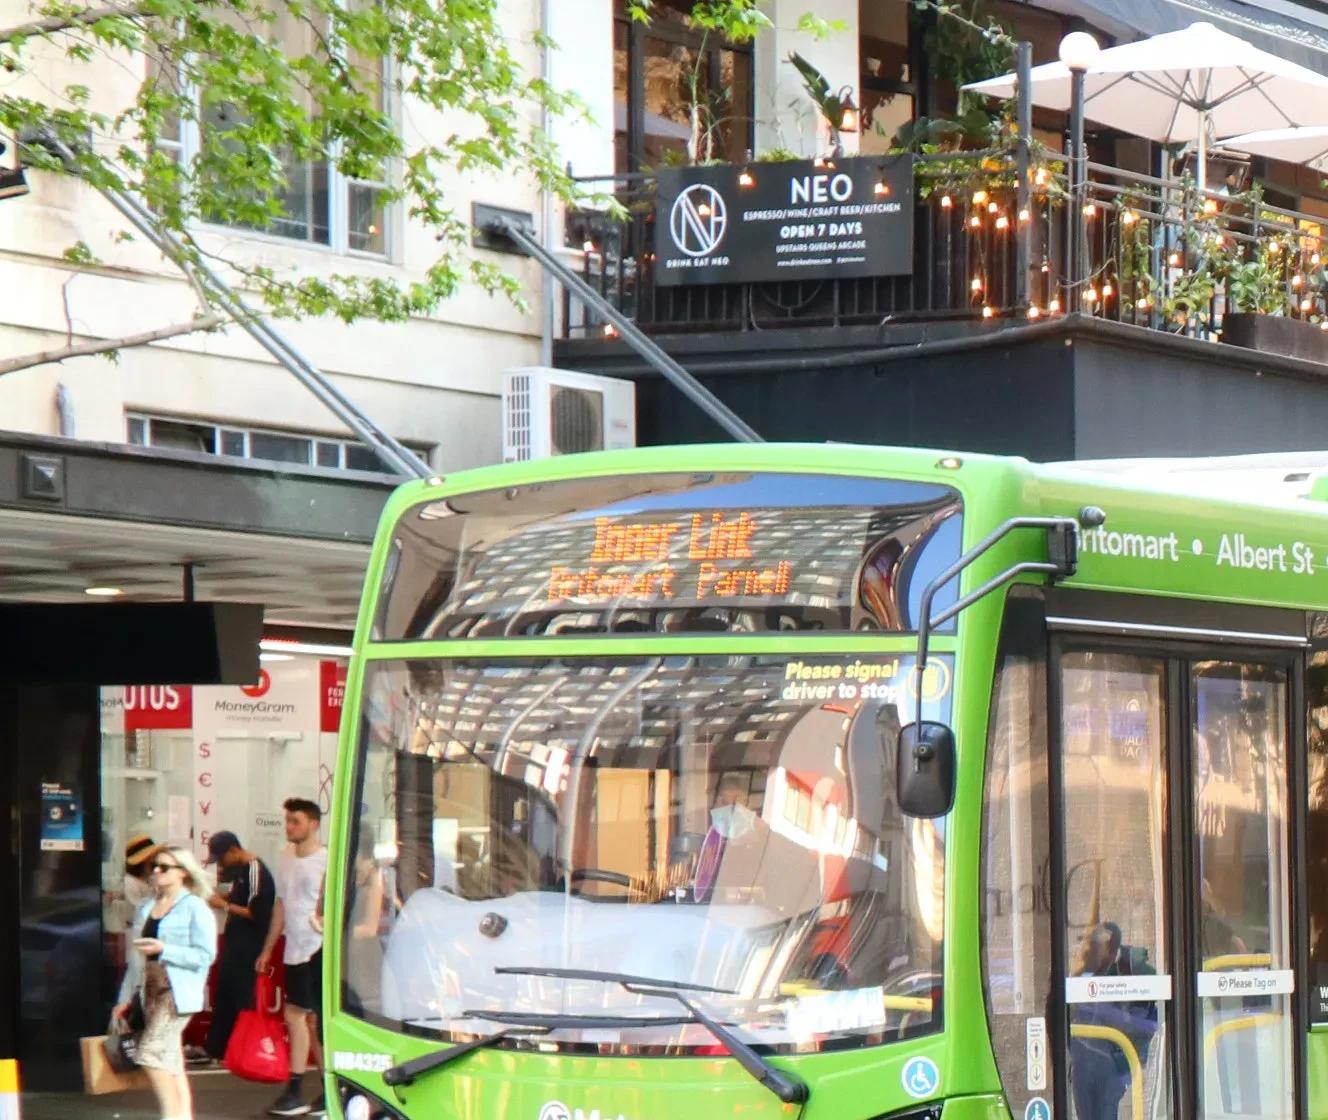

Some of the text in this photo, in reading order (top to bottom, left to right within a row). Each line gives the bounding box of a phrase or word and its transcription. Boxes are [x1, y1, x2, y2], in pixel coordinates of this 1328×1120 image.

[790, 174, 853, 204] NEO
[780, 222, 862, 239] OPEN 7 DAYS
[776, 244, 808, 253] UPSTAIRS
[666, 256, 730, 268] DRINK EAT NEO
[689, 512, 756, 558] Link
[1076, 526, 1180, 562] ritomart
[1216, 533, 1288, 572] Albert
[1291, 540, 1315, 575] St
[784, 659, 899, 683] Please signal
[783, 682, 905, 702] driver to stop
[214, 700, 295, 714] MoneyGram
[1229, 976, 1251, 988] Please
[1253, 978, 1267, 990] Tag
[1267, 979, 1277, 988] on
